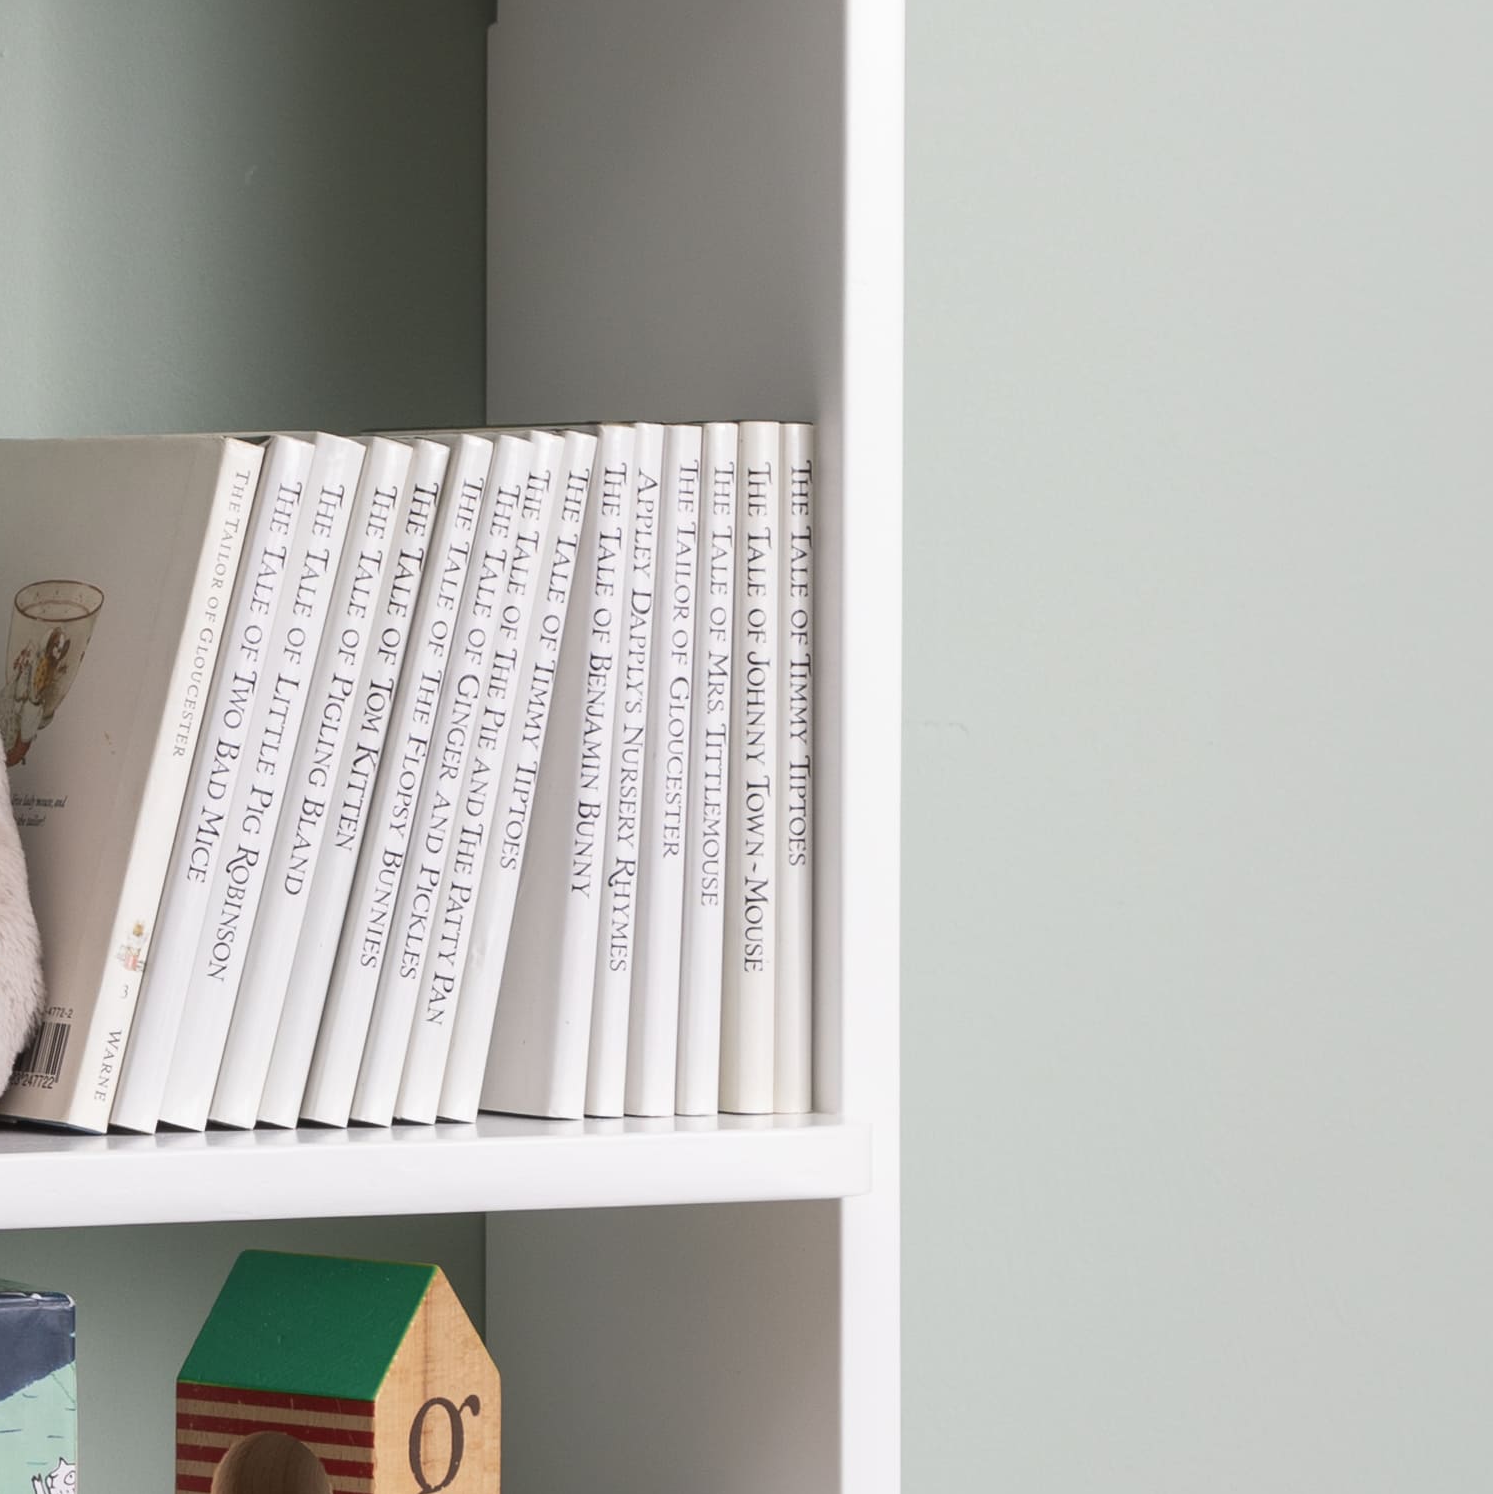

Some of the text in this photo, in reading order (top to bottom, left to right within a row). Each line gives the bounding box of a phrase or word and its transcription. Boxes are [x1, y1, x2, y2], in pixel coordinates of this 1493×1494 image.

[172, 470, 251, 757] THE TAILOR OF GLOUCESTER
[186, 481, 303, 883] THE TALE OF TWO BAD MICE
[335, 482, 440, 851] THE TALE OF TOM KITTEN
[499, 468, 591, 870] THE TALE OF TIMMY TIPTOES
[571, 462, 628, 898] THE TALE OF BENJAMIN BUNNY
[632, 467, 659, 578] APPLEY
[662, 459, 700, 858] THE TAILOR OF GLOUCESTER
[700, 461, 735, 906] THE TALE OF MRS. TITTLEMOUSE
[747, 462, 772, 517] THE
[747, 526, 772, 597] TALE
[747, 608, 766, 643] OF
[788, 459, 813, 867] THE TALE OF TIMMY TIPTOES
[207, 484, 346, 982] THE TALE OF LITTLE PIG ROBINSON
[284, 485, 398, 896] THE TALE OF PIGLING BLAND
[360, 477, 485, 968] THE TALE OF THE FLOPSY BUNNIES
[399, 484, 522, 980] THE TALE OF GINGER AND PICKLES
[426, 469, 552, 1025] THE TALE OF THE PIE AND THE PATTY PAN
[616, 723, 645, 848] NURSERY
[745, 650, 771, 766] JOHNNY
[94, 1029, 123, 1102] WARNE
[608, 856, 637, 972] RHYMES
